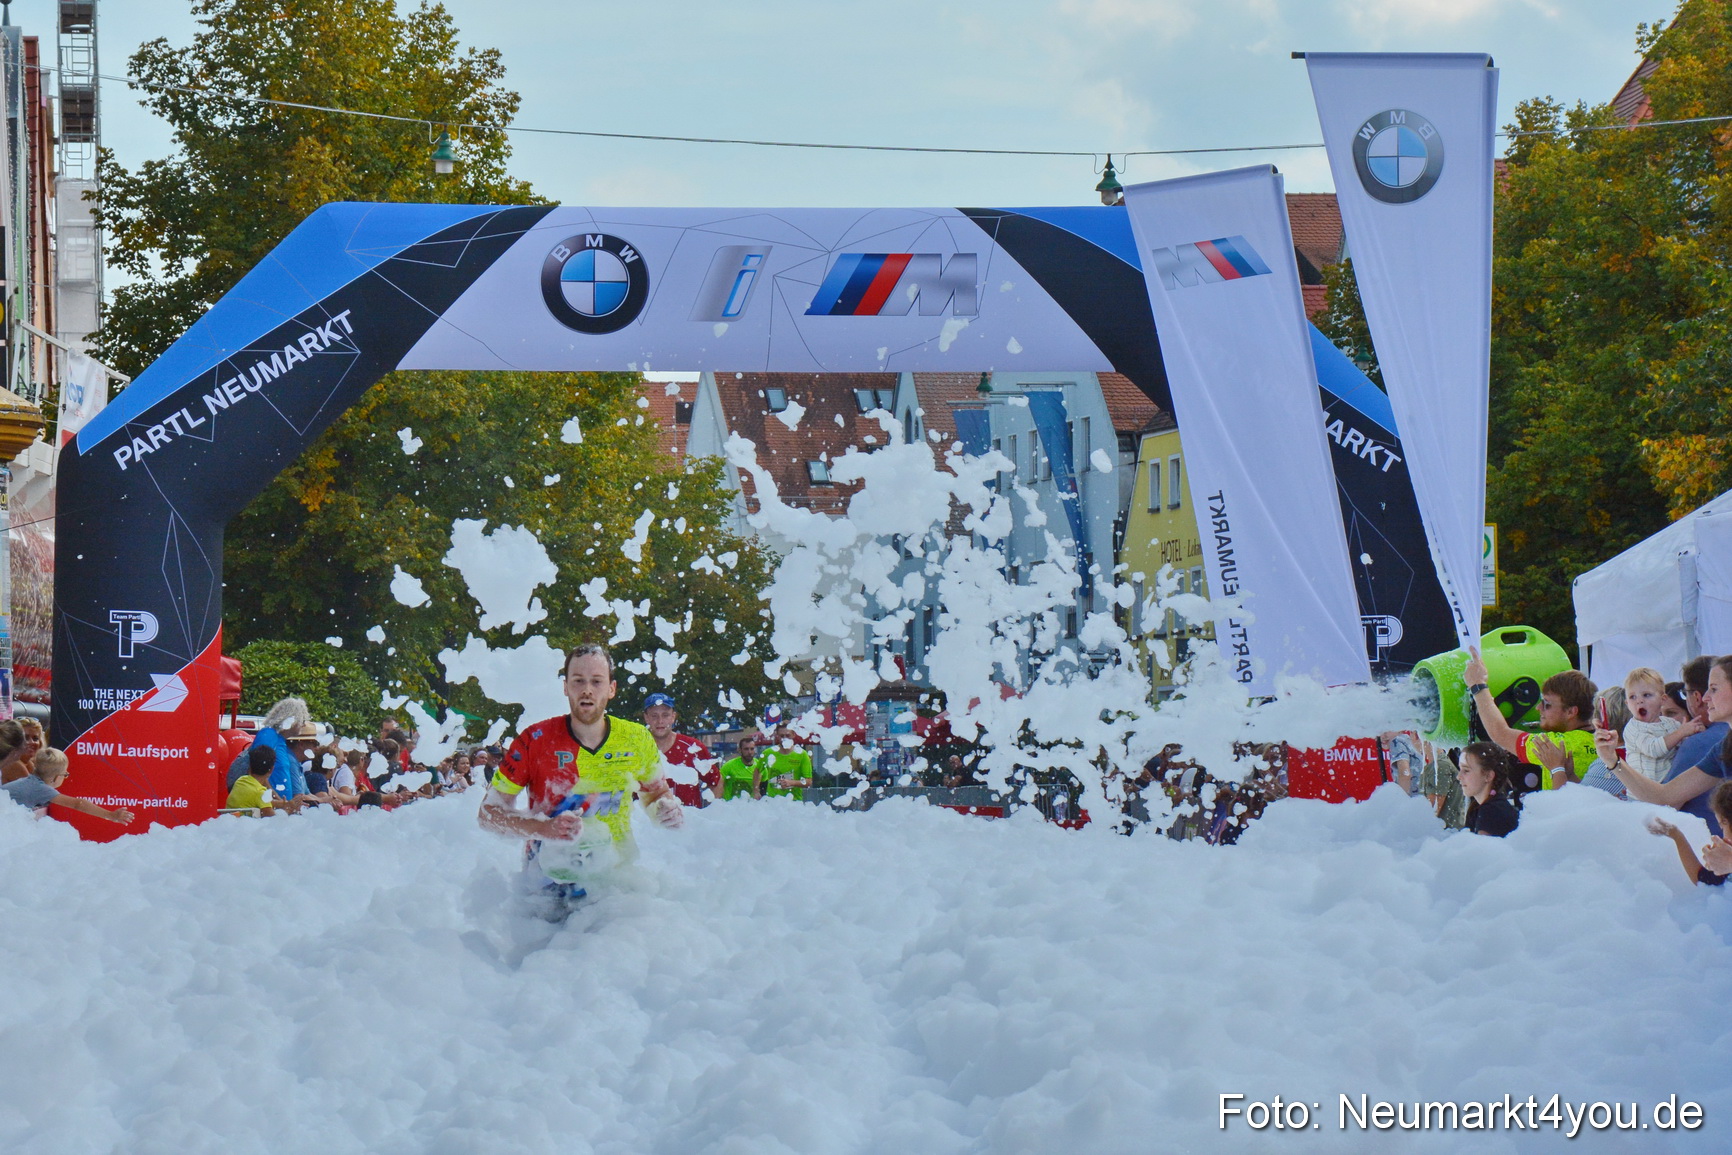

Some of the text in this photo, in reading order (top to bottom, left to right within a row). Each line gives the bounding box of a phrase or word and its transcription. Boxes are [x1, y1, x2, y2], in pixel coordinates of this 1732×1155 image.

[551, 234, 640, 264] BMW
[112, 407, 206, 471] PARTL
[202, 309, 354, 416] NEUMARKT
[1322, 410, 1402, 473] ARKT
[1160, 538, 1183, 563] HOTEL
[93, 688, 146, 701] THE NEXT
[77, 699, 132, 711] 100 YEARS
[76, 741, 189, 761] BMW Laufsport
[1323, 748, 1364, 762] BMW
[75, 794, 189, 810] ww.bmw-partl.de
